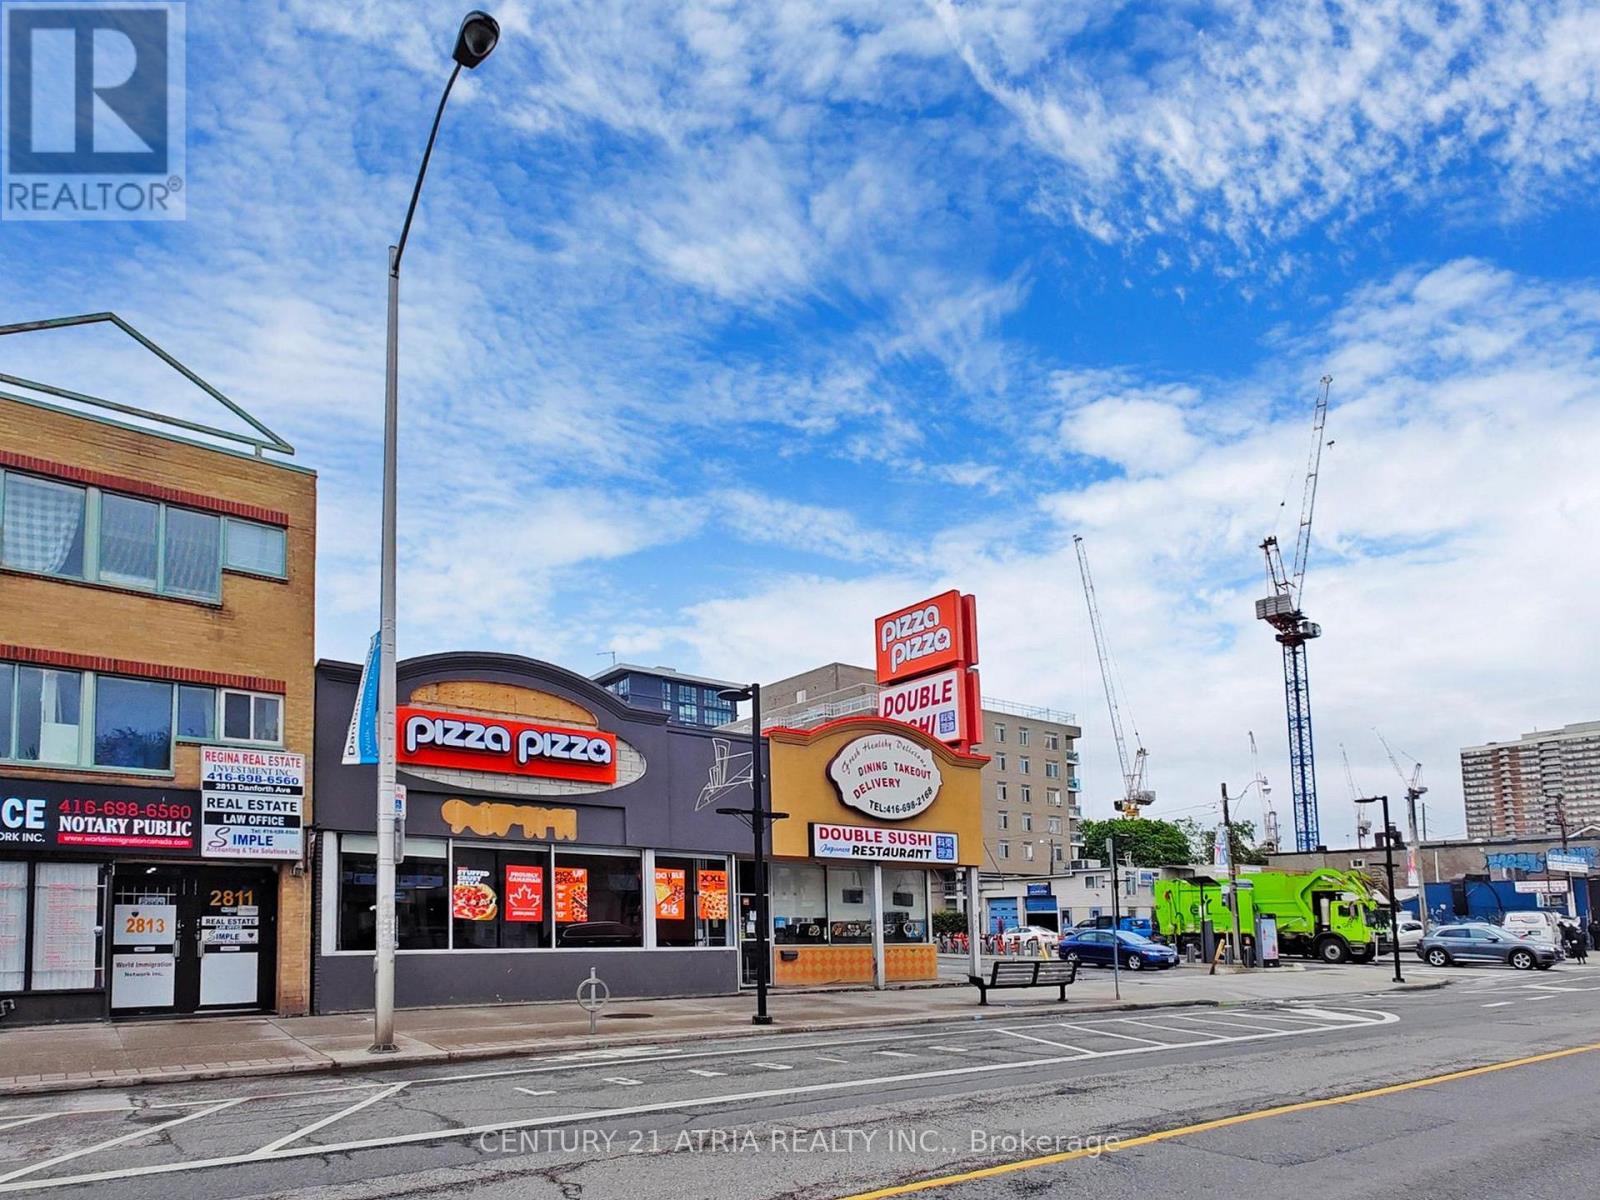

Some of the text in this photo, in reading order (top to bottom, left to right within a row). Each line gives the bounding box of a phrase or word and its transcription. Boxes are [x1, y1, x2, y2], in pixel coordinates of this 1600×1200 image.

[882, 605, 939, 652] pizza
[891, 627, 951, 674] pizza
[883, 679, 953, 717] DOUBLE
[405, 715, 613, 765] pizza pizza
[205, 751, 302, 768] REGINA REAL ESTATE
[213, 764, 272, 775] INVESTMENT
[858, 761, 932, 780] DINING TAKEOUT
[207, 772, 299, 785] 416-698-6560
[238, 784, 274, 793] Danforth
[275, 786, 291, 794] Ave
[853, 778, 901, 800] DELIVERY
[58, 800, 192, 819] 416-698-6560
[206, 797, 298, 812] REAL ESTATE
[58, 816, 192, 837] NOTARY PUBLIC
[223, 814, 285, 826] LAW OFFICE
[22, 832, 46, 843] INC.
[819, 827, 932, 846] DOUBLE SUSHI
[851, 845, 932, 859] RESTAURANT
[701, 874, 724, 882] XXL
[210, 890, 253, 906] 2811
[126, 918, 165, 933] 2813
